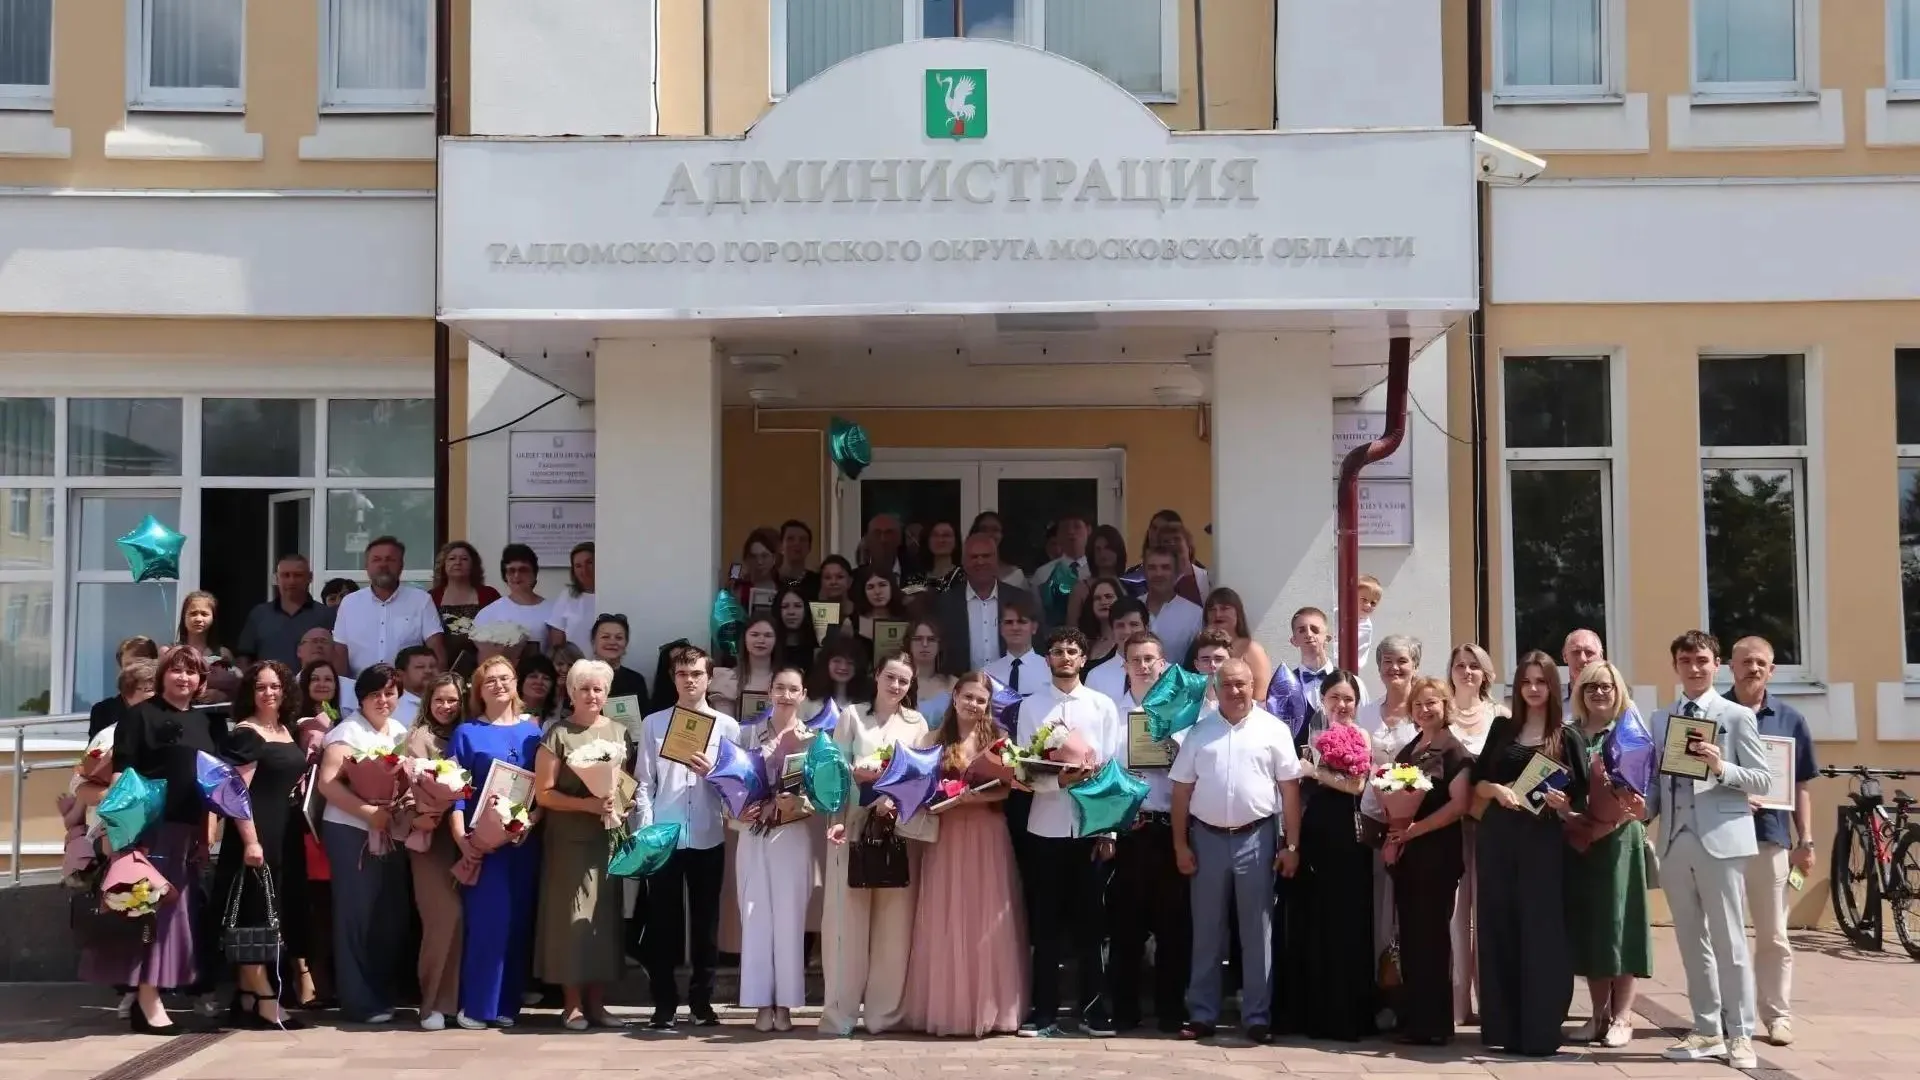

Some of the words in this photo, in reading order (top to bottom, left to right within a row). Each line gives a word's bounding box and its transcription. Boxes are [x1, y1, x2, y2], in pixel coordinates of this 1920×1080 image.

[661, 157, 1260, 216] АДМИНИСТРАЦИЯ
[488, 241, 717, 267] ТАЛДОМСКОГО
[723, 239, 922, 266] ГОРОДСКОГО
[928, 238, 1043, 262] ОКРУГА
[1048, 233, 1265, 261] МОСКОВСКОЙ
[1272, 236, 1416, 260] ОБЛАСТИ
